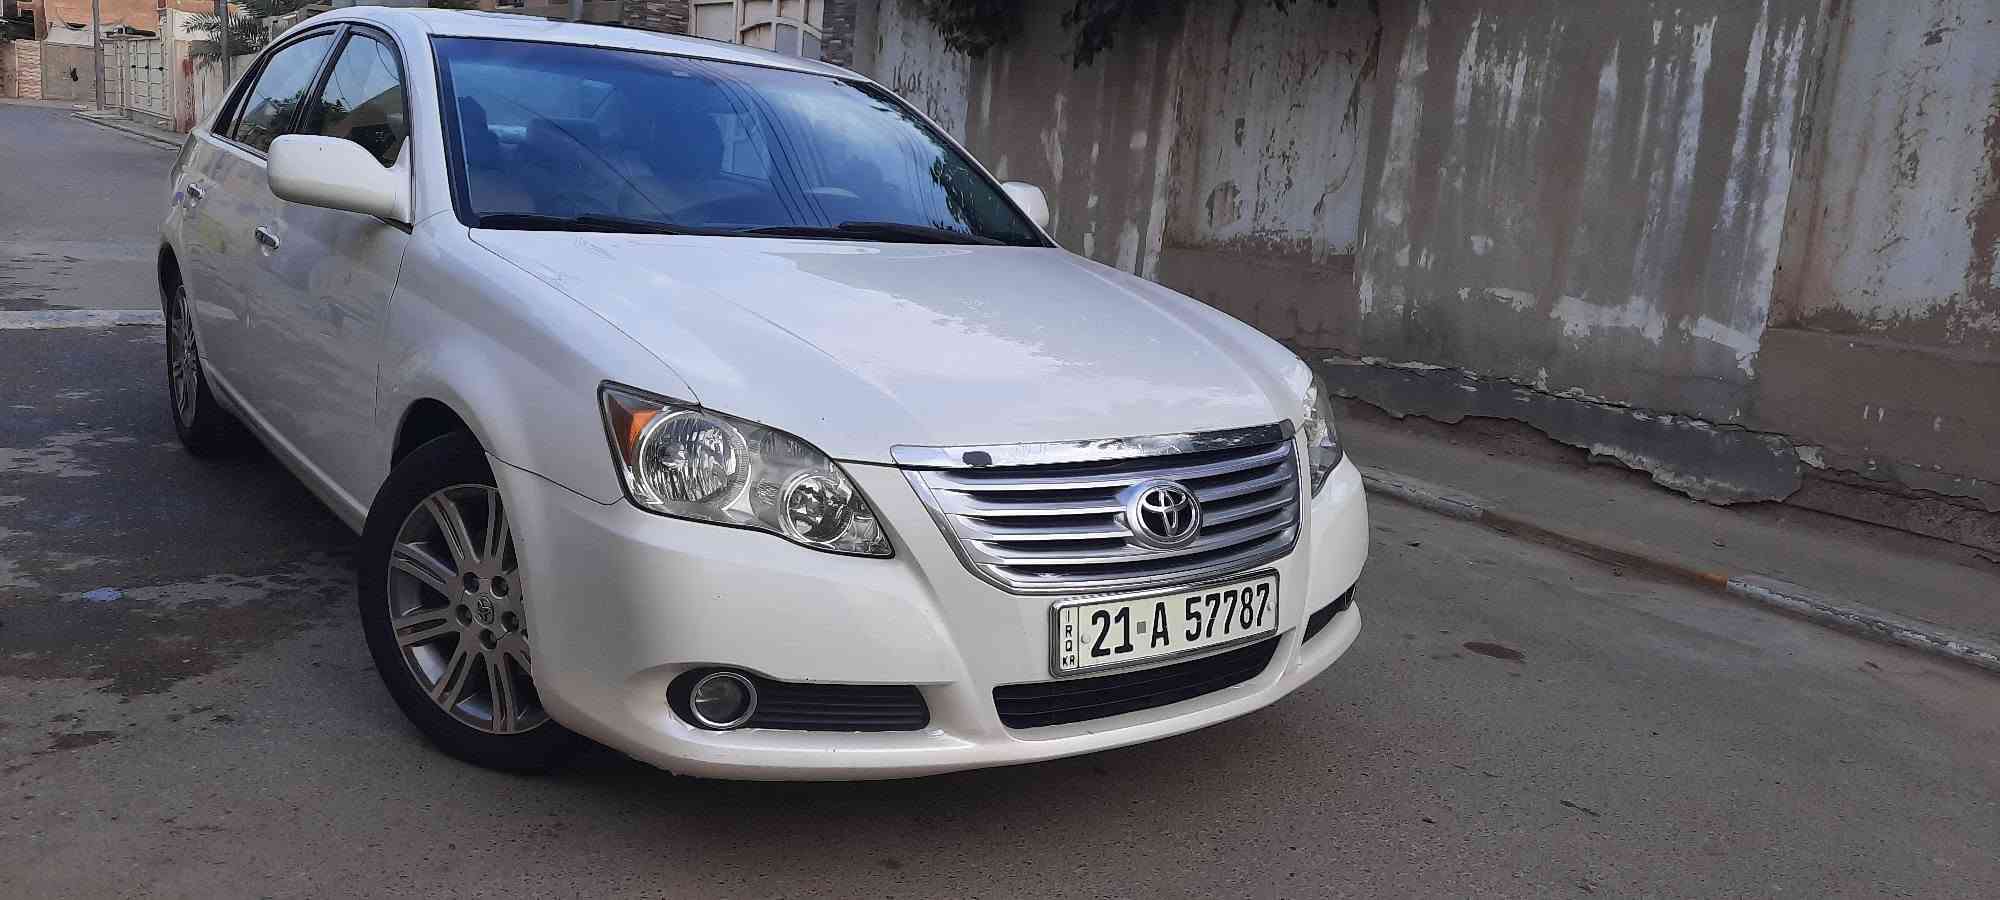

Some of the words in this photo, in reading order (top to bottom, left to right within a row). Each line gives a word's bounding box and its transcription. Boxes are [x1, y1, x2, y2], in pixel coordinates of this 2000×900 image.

[1091, 607, 1134, 658] 21
[1151, 602, 1170, 648] A
[1185, 583, 1270, 641] 57787
[1062, 654, 1075, 667] KR
